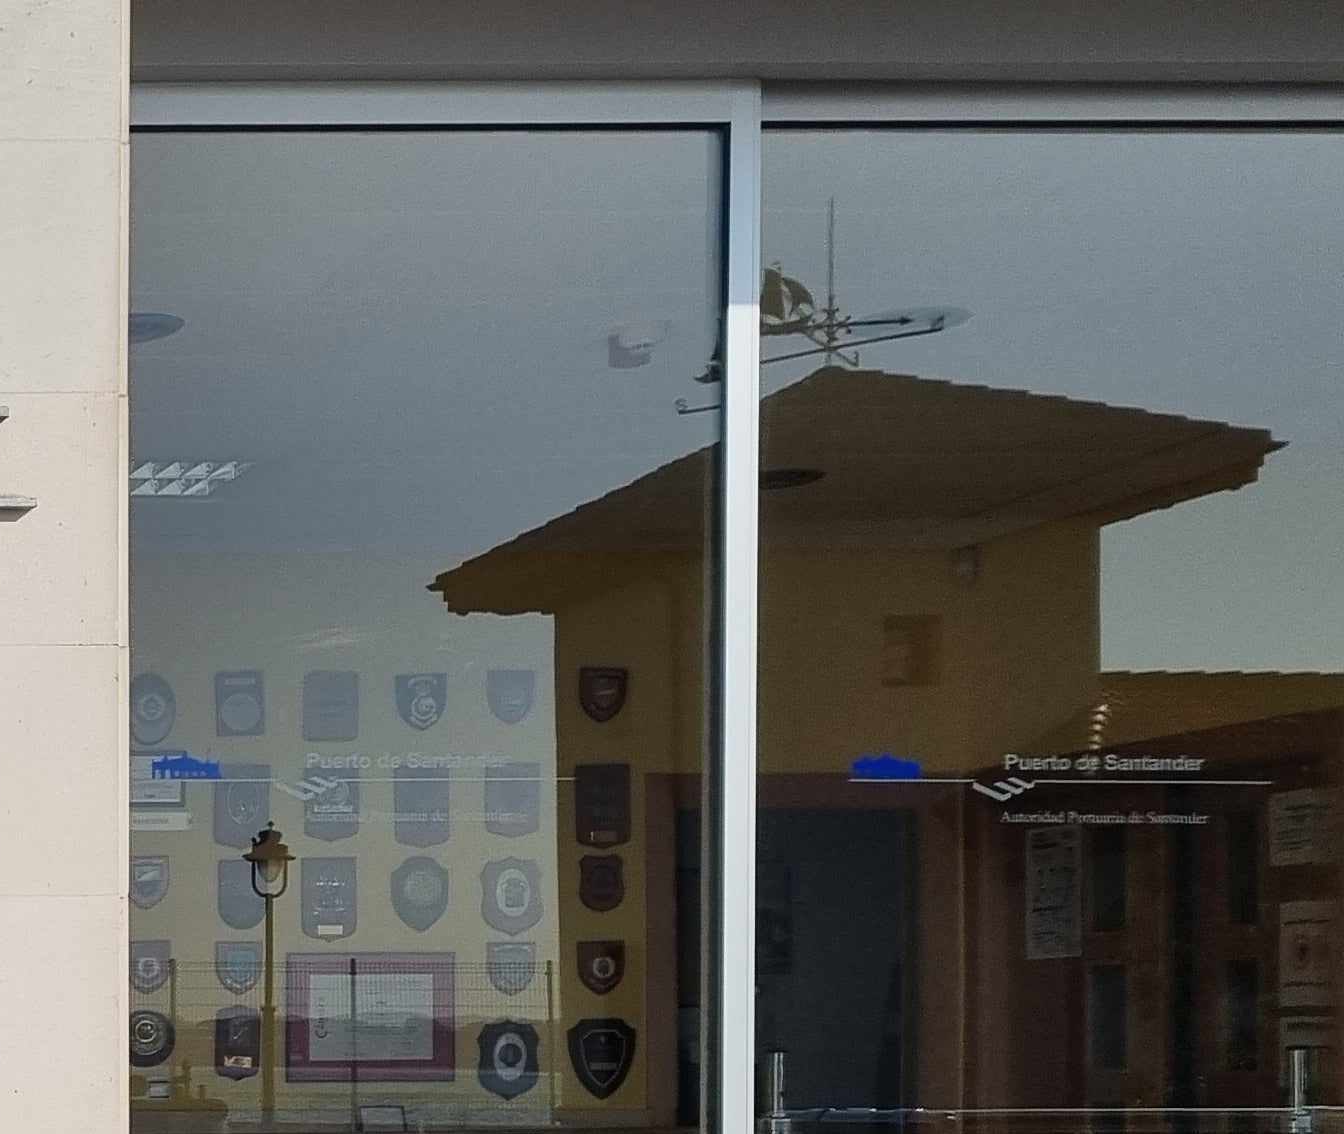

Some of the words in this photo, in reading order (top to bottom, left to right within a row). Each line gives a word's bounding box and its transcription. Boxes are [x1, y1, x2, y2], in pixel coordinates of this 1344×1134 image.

[1003, 753, 1072, 771] Puerto
[1074, 753, 1101, 771] de
[1104, 753, 1206, 771] Santander
